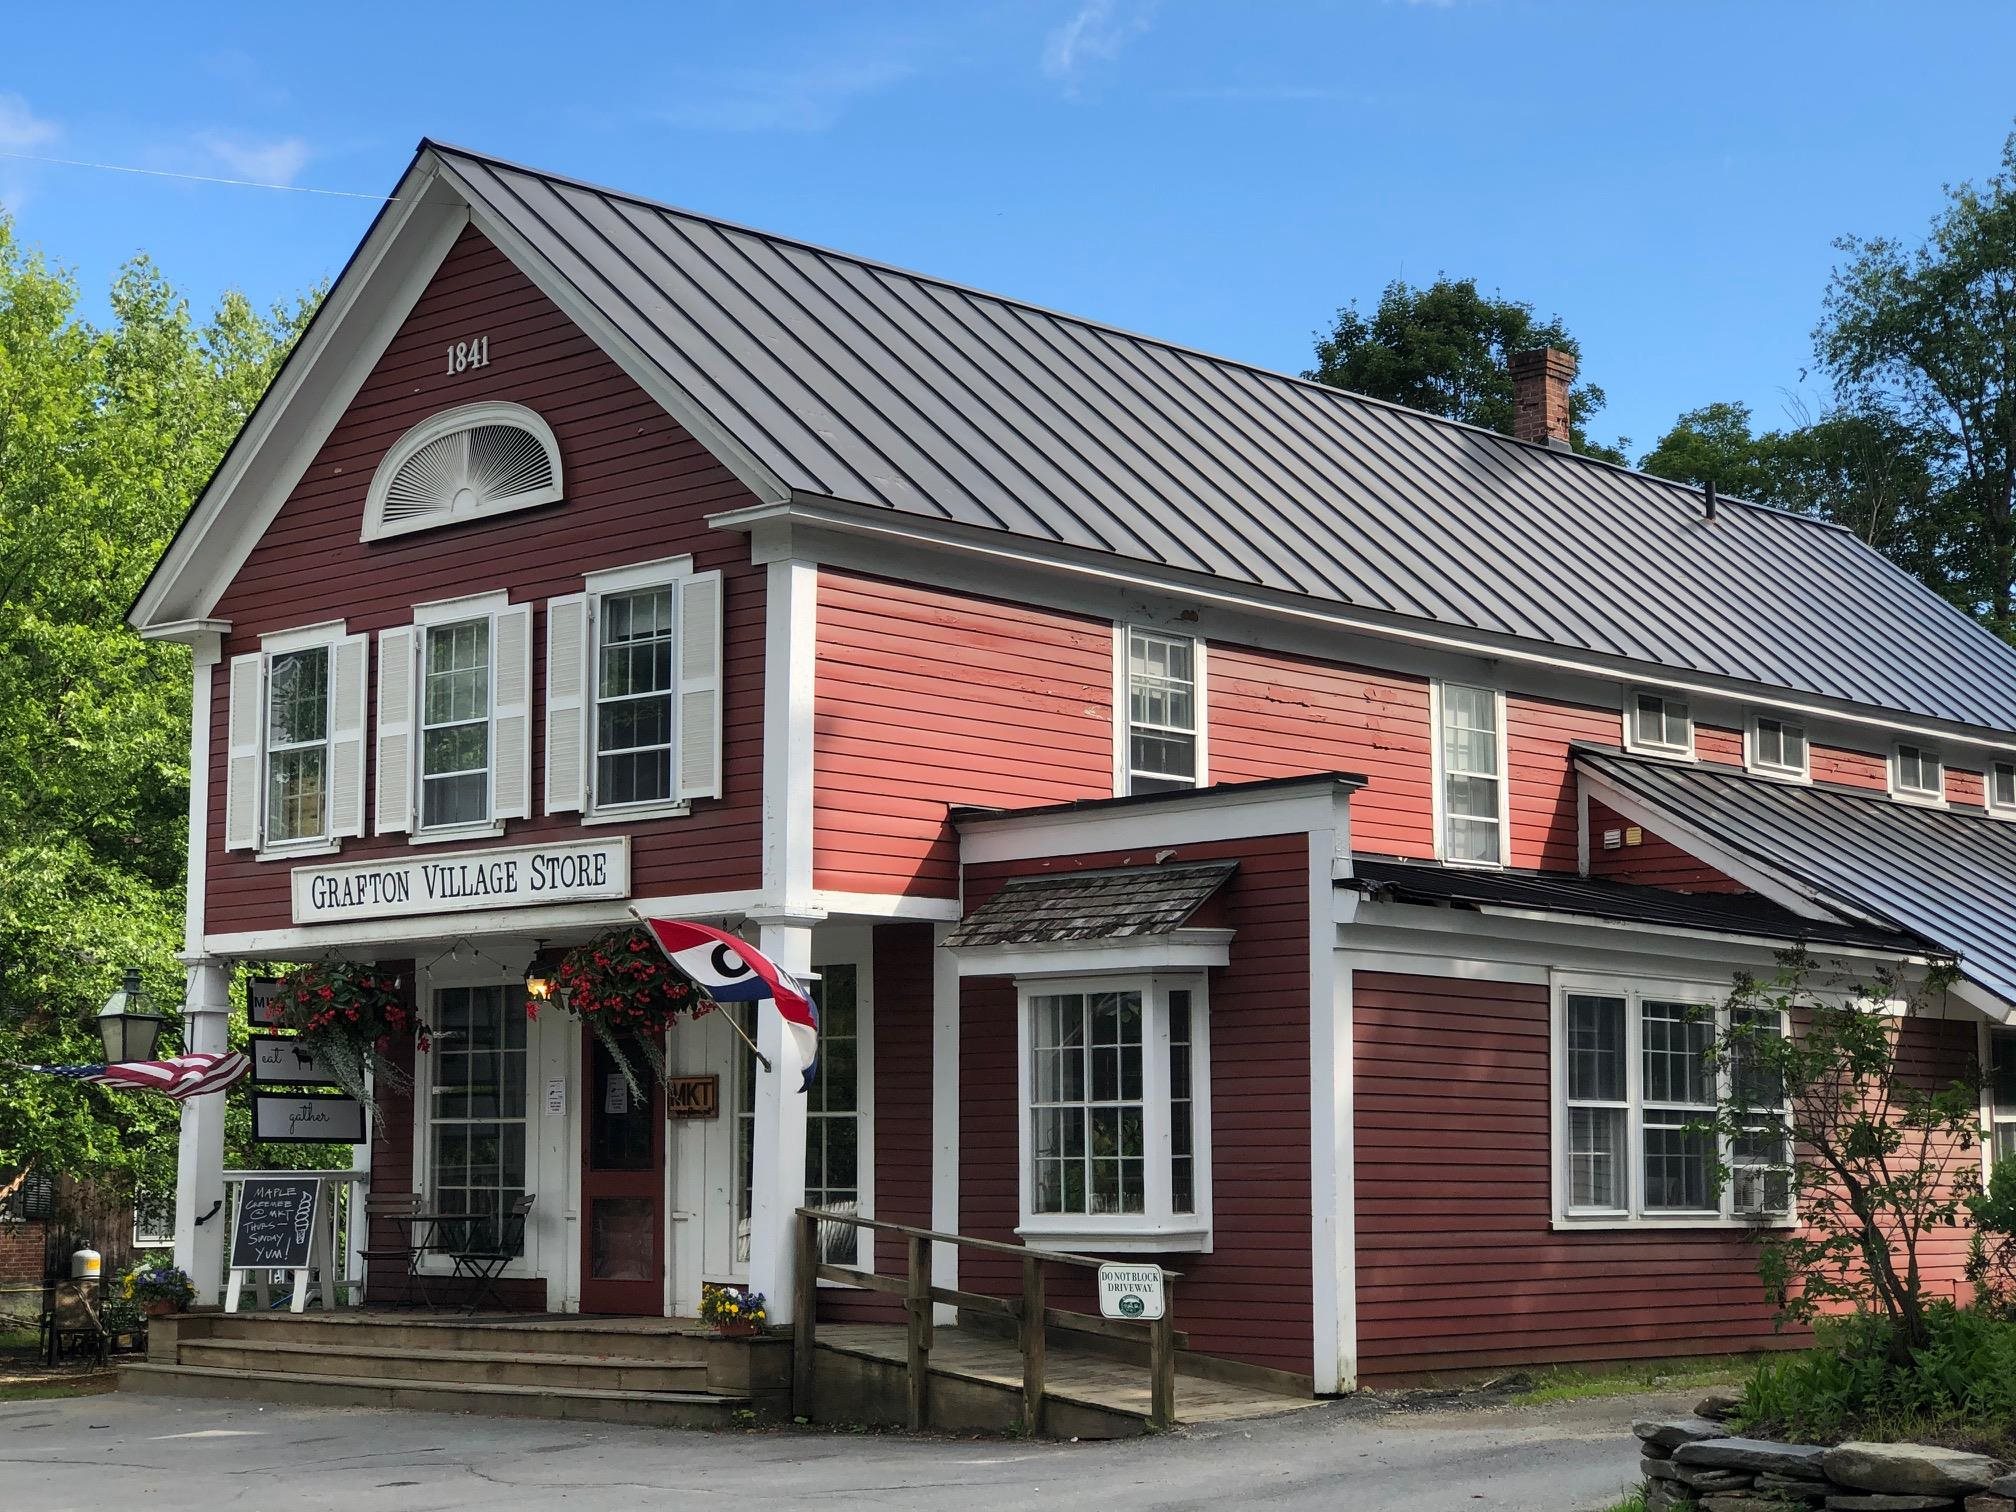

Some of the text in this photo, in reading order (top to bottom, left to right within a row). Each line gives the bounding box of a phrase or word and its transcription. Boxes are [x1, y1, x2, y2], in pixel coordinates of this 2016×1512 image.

[446, 336, 490, 375] 1841
[311, 852, 607, 910] GRAFTON VILLAGE STORE
[261, 1048, 284, 1064] eat
[669, 1082, 713, 1106] MKT
[289, 1102, 330, 1135] gather
[253, 1187, 297, 1199] MAPLE
[269, 1210, 294, 1221] MKT
[248, 1233, 284, 1246] SUNDAY
[1101, 1272, 1159, 1282] DO NOT BLOCK
